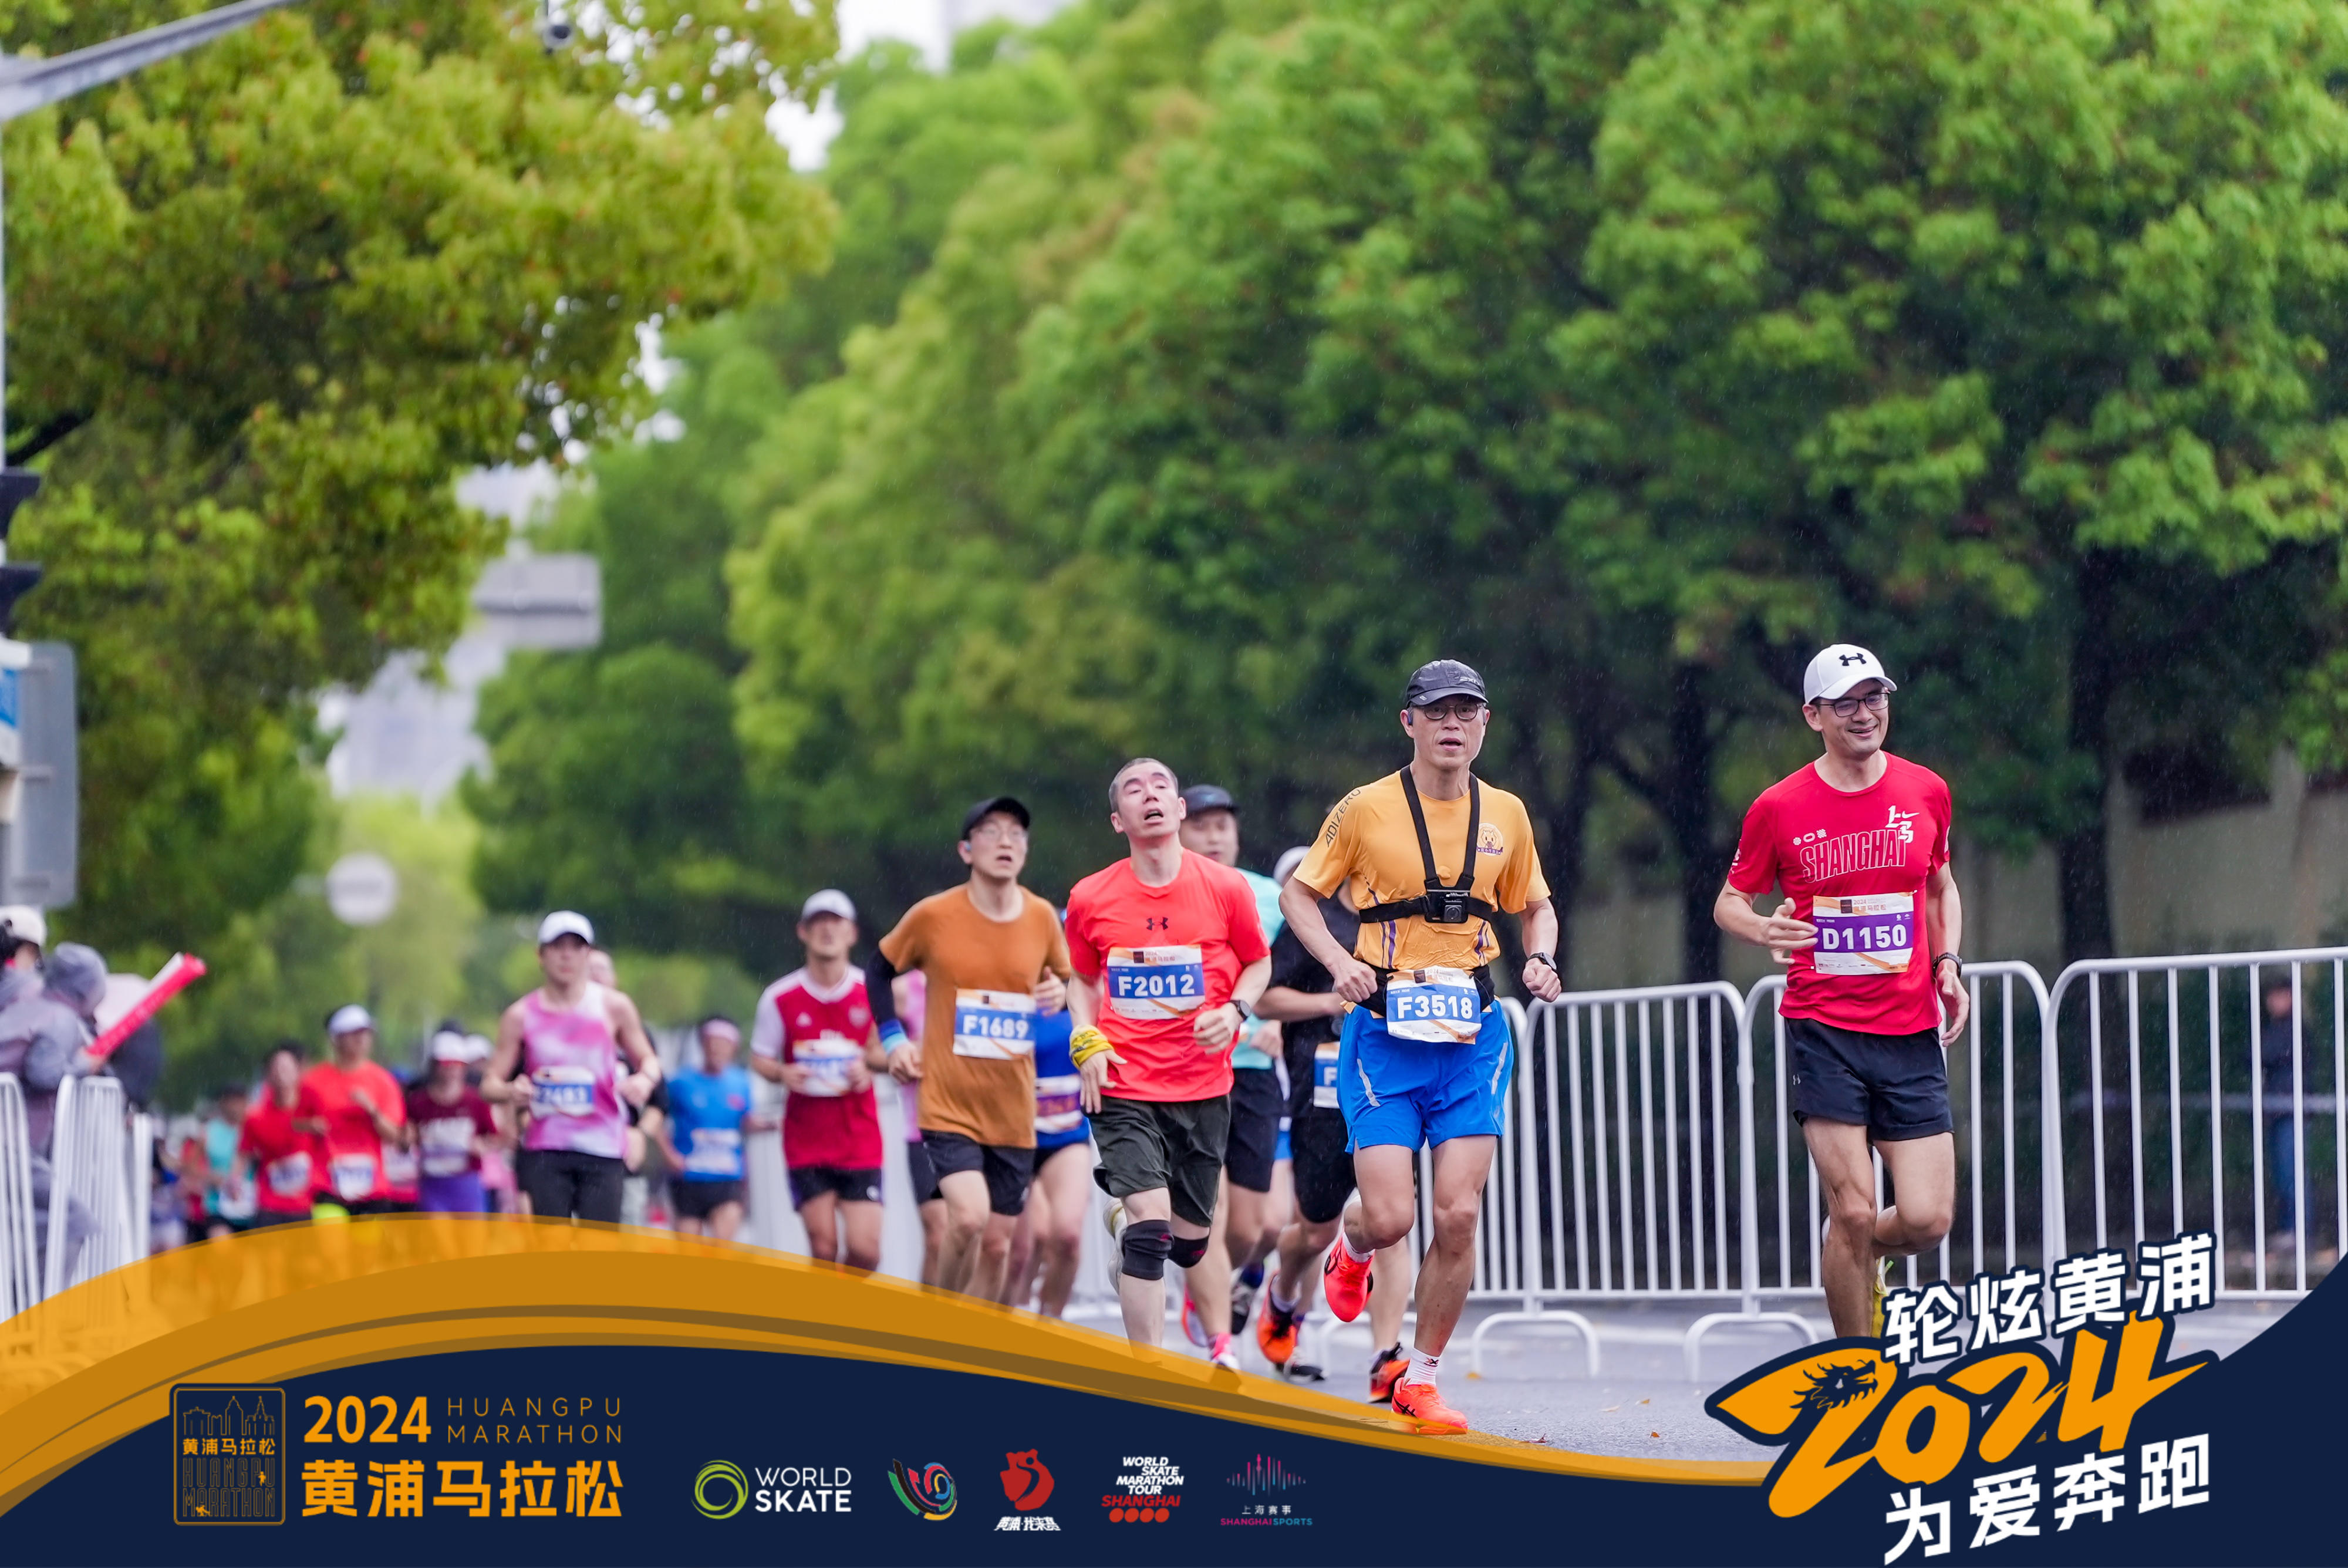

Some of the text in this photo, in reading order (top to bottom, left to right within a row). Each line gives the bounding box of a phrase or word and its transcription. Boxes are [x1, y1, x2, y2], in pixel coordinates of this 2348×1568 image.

[1325, 789, 1361, 847] ADIZERO
[1800, 829, 1907, 883] SHANGHAI
[1822, 924, 1907, 950] D1150
[1118, 974, 1195, 996] F2012
[1397, 994, 1473, 1019] F3518
[963, 1014, 1029, 1039] F1689
